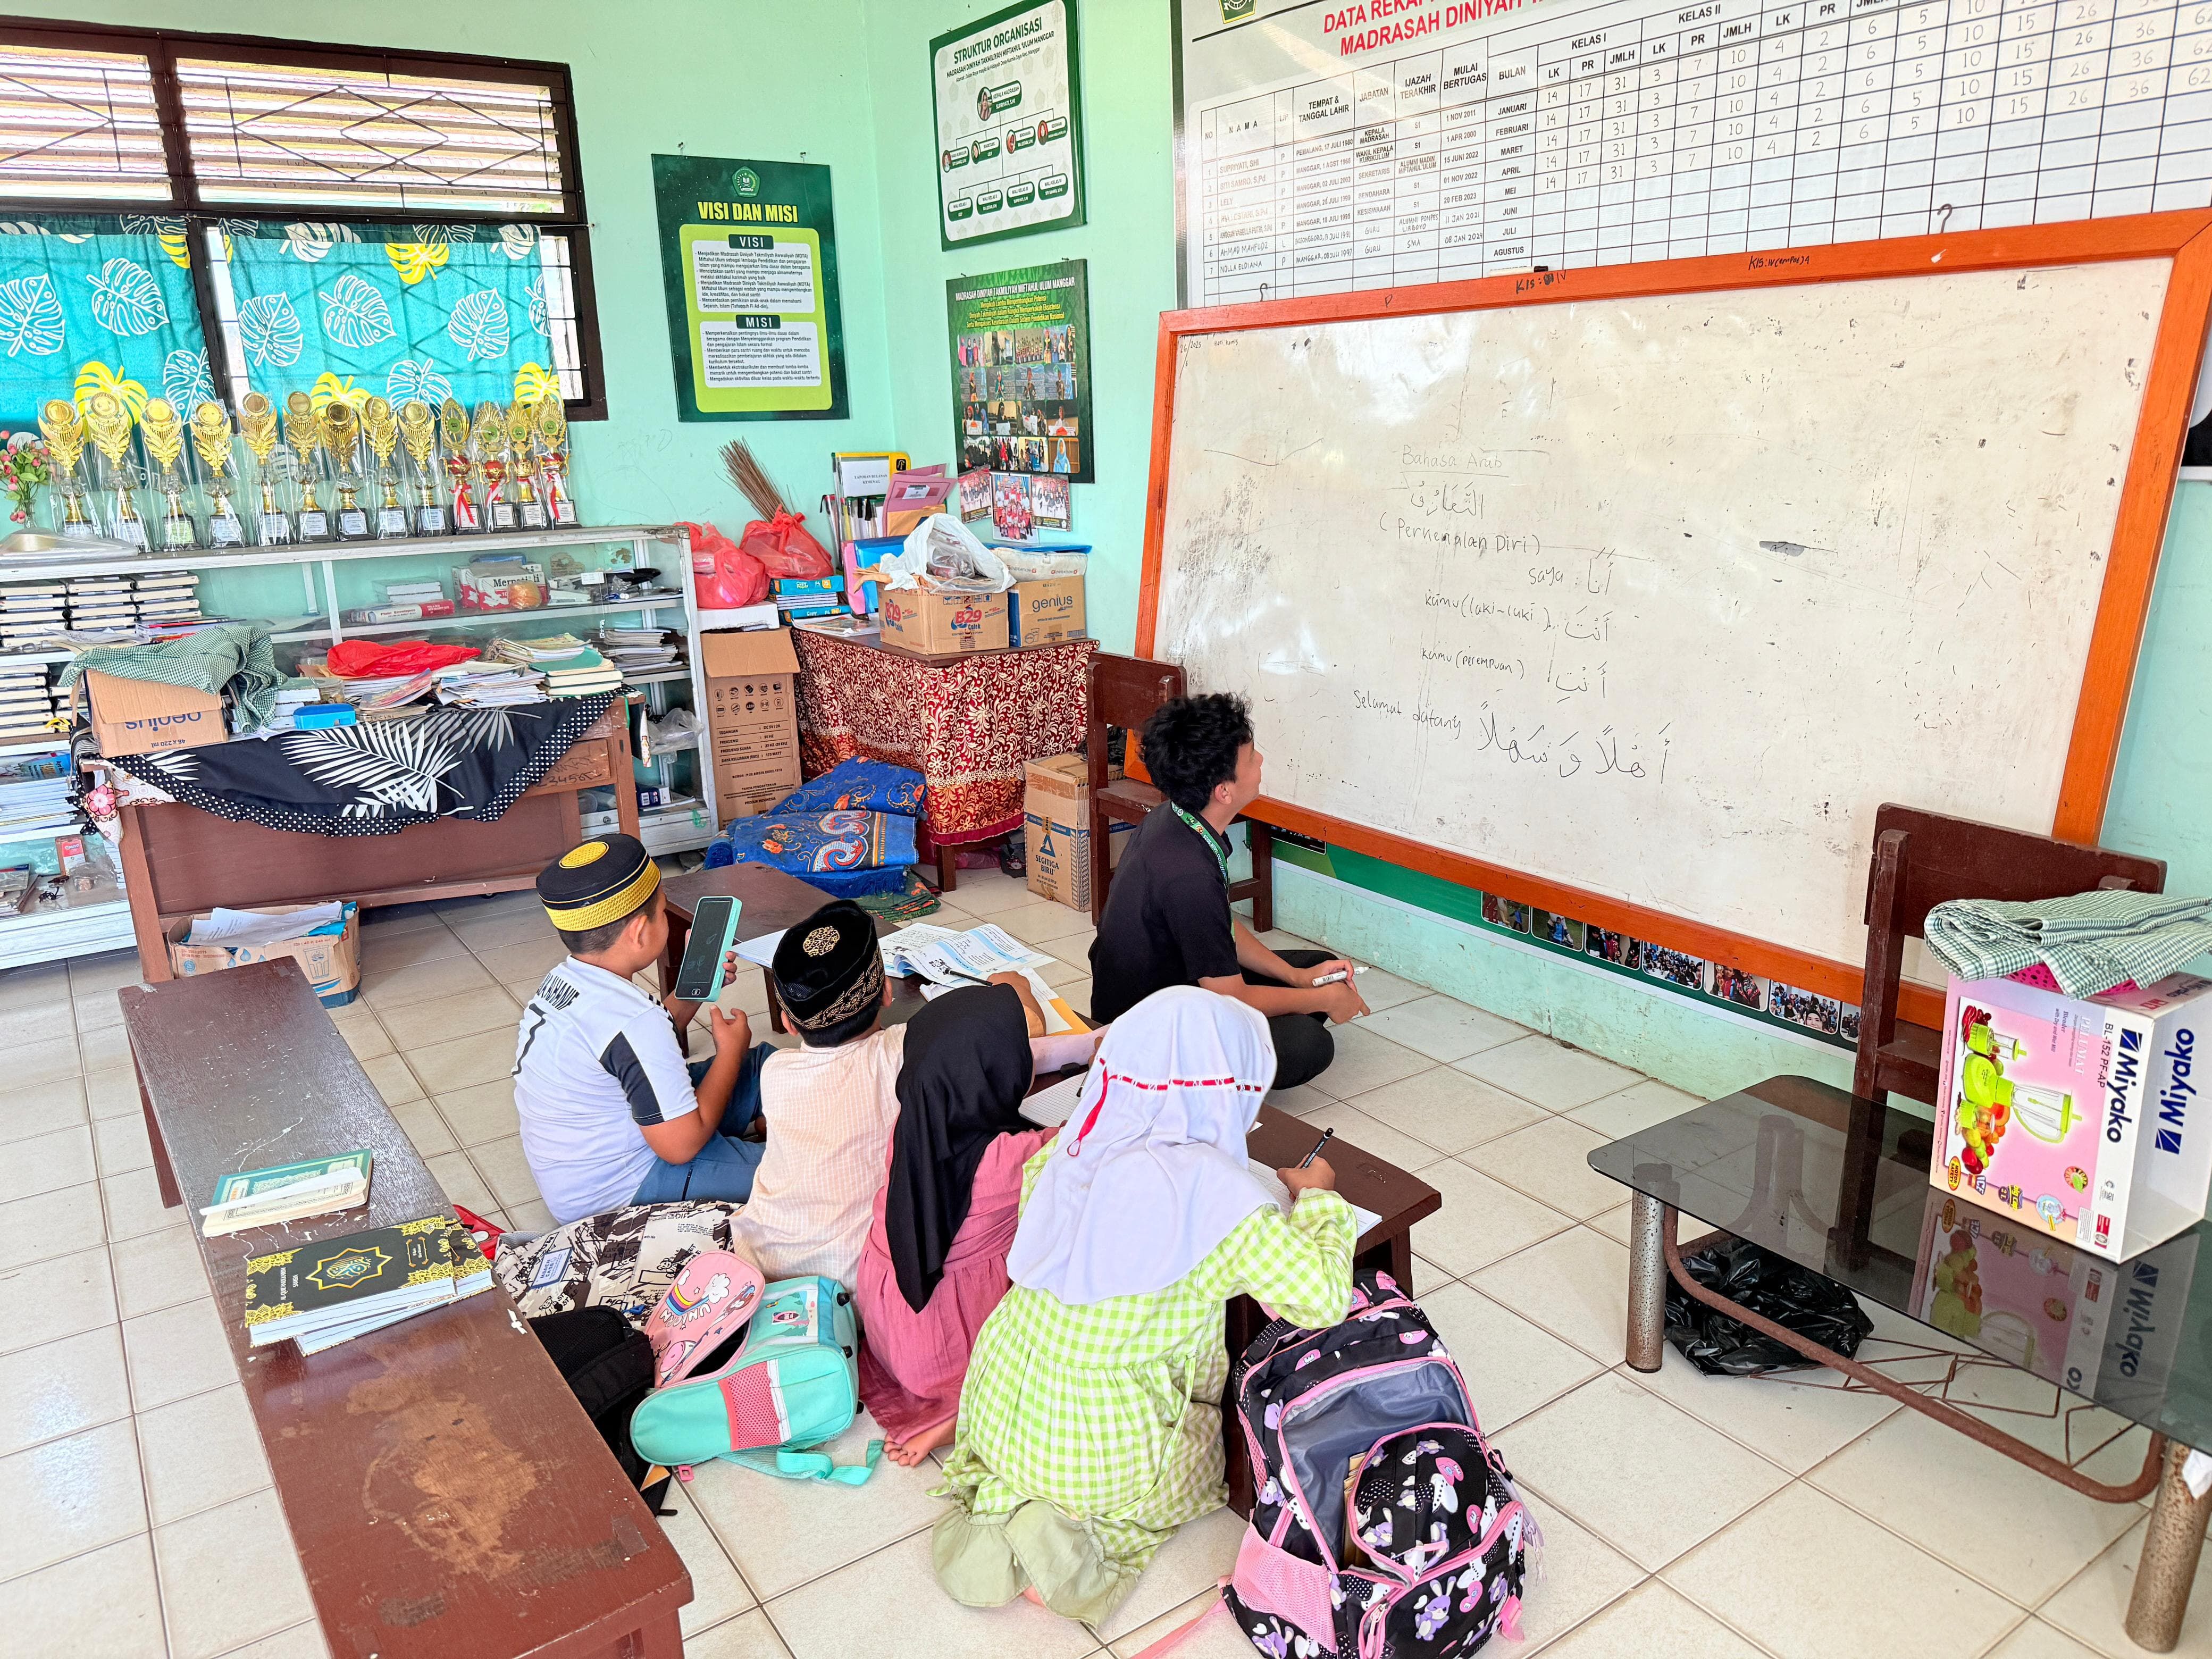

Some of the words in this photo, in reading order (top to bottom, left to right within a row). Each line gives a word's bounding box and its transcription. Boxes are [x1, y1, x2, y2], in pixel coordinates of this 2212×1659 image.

[1678, 7, 1712, 23] KELAS
[1715, 4, 1721, 14] II
[1820, 4, 1835, 16] PR
[1920, 9, 1928, 23] 5
[1324, 5, 1367, 33] DATA
[1776, 13, 1790, 26] LK
[1340, 11, 1439, 56] MADRASAH
[1723, 22, 1752, 38] JMLH
[1868, 20, 1876, 35] 6
[954, 38, 991, 64] STRUKTUR
[993, 17, 1042, 48] ORGANISASI
[1572, 35, 1601, 49] KELAS
[1604, 33, 1606, 42] I
[1691, 34, 1705, 46] PR
[1820, 31, 1828, 46] 2
[2075, 30, 2092, 46] 26
[1653, 43, 1666, 54] LK
[1775, 39, 1783, 53] 4
[1610, 50, 1635, 64] JMLH
[1732, 49, 1746, 64] 10
[1454, 63, 1478, 76] MULAI
[1582, 60, 1594, 71] PR
[1694, 58, 1701, 71] 7
[1405, 73, 1431, 87] IJAZAH
[1499, 66, 1526, 80] BULAN
[1548, 68, 1560, 78] LK
[1654, 69, 1661, 81] 3
[1443, 73, 1487, 90] BERTUGAS
[1615, 77, 1626, 90] 31
[1359, 87, 1388, 102] JABATAN
[1400, 85, 1436, 99] TERAKHIR
[1548, 91, 1557, 103] 14
[1580, 83, 1591, 97] 17
[1309, 98, 1333, 110] TEMPAT
[1498, 103, 1527, 116] JANUARI
[1298, 107, 1329, 123] TANGGAL
[1330, 104, 1350, 118] LAHIR
[1364, 127, 1385, 136] KEPALA
[1496, 123, 1529, 136] FEBRUARI
[1360, 133, 1389, 144] MADRASAH
[1356, 149, 1371, 158] WAKIL
[1372, 145, 1394, 155] KEPALA
[1501, 145, 1523, 155] MARET
[1220, 162, 1249, 173] SUPRIYATI,
[1502, 166, 1521, 175] APRIL
[697, 202, 729, 220] VISI
[732, 203, 764, 221] DAN
[765, 204, 798, 223] MISI
[1503, 207, 1517, 216] JUNI
[1365, 225, 1380, 234] GURU
[1502, 227, 1516, 236] JULI
[740, 237, 764, 247] VISI
[1407, 240, 1420, 248] SMA
[1220, 246, 1240, 256] AHMAD
[1365, 245, 1380, 254] GURU
[1494, 246, 1524, 257] AGUSTUS
[1220, 263, 1237, 273] NOLLA
[1238, 261, 1262, 270] ELDIANA
[956, 292, 976, 301] MADRASAH
[1040, 281, 1051, 290] ULUM
[1052, 277, 1075, 288] MANGGAR
[746, 317, 772, 328] MISI
[1402, 445, 1457, 468] Bahasa
[1467, 453, 1502, 468] Arab
[1529, 567, 1563, 585] saya
[1032, 596, 1073, 613] genius
[885, 602, 901, 622] B29
[956, 609, 982, 624] B29
[1354, 690, 1402, 716] Selamat
[1035, 855, 1059, 869] SEGITIGA
[1041, 865, 1054, 875] BIRU
[2101, 1023, 2114, 1056] BL-152
[2097, 1057, 2108, 1088] PF-AP
[2159, 1028, 2197, 1127] Miyako
[2107, 1051, 2139, 1143] Miyako
